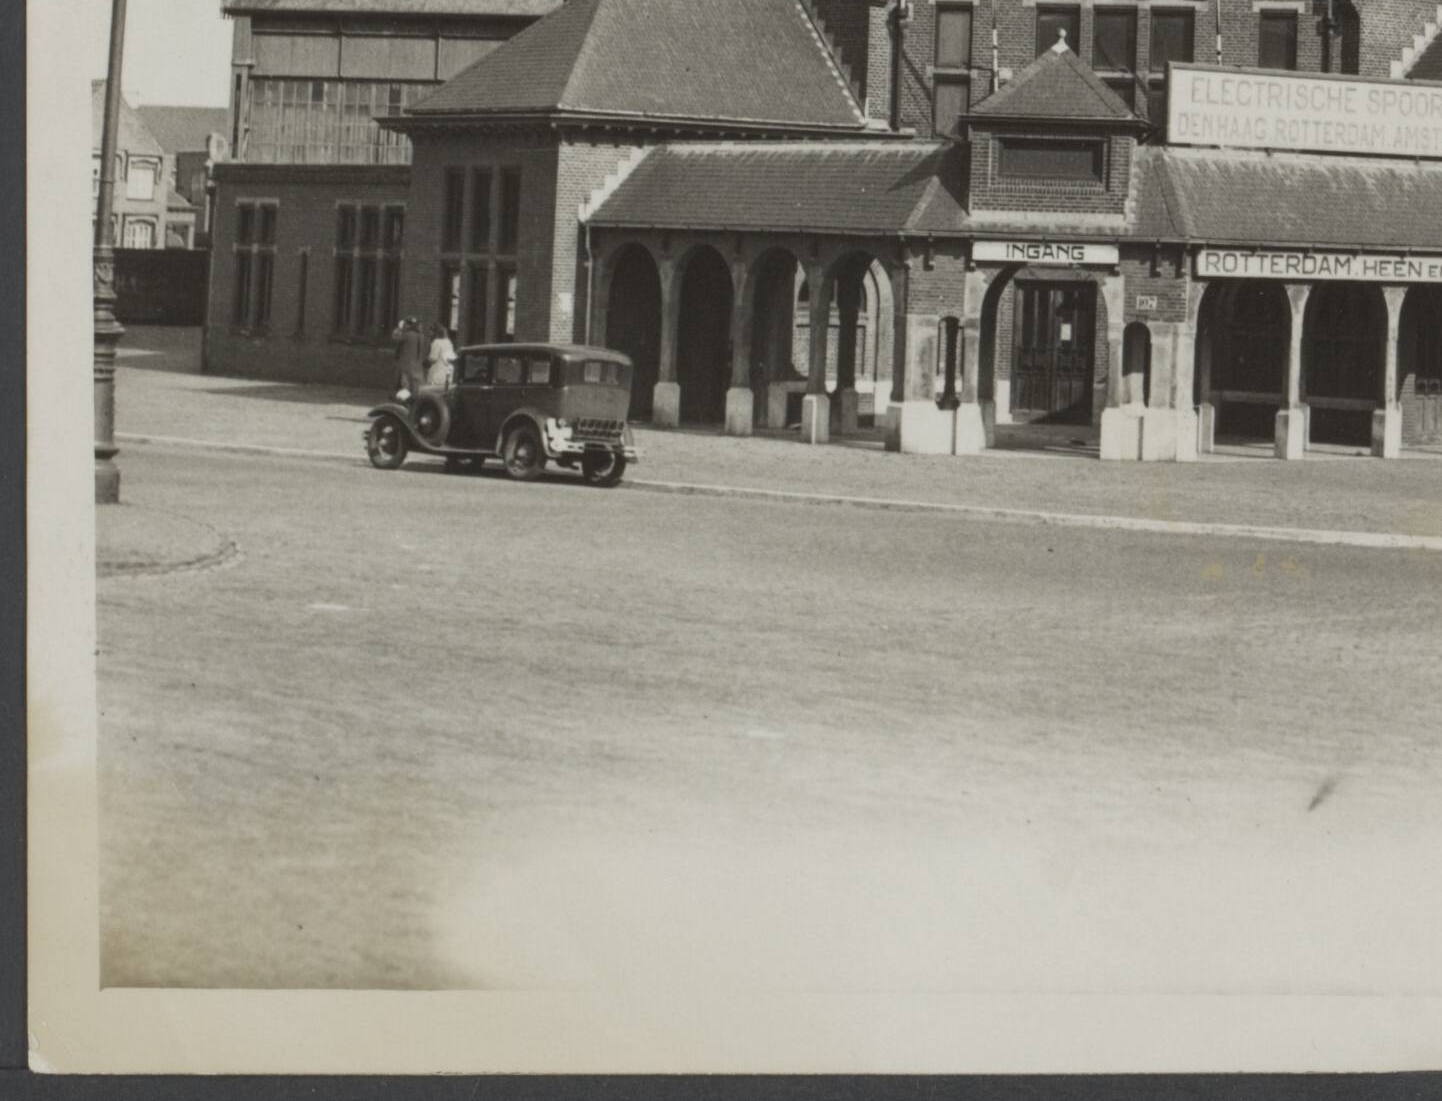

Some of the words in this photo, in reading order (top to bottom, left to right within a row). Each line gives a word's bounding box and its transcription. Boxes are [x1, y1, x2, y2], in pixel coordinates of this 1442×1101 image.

[1191, 76, 1357, 113] ELECTRISCHE
[1006, 243, 1085, 260] INGANG
[1363, 259, 1422, 278] HEEN
